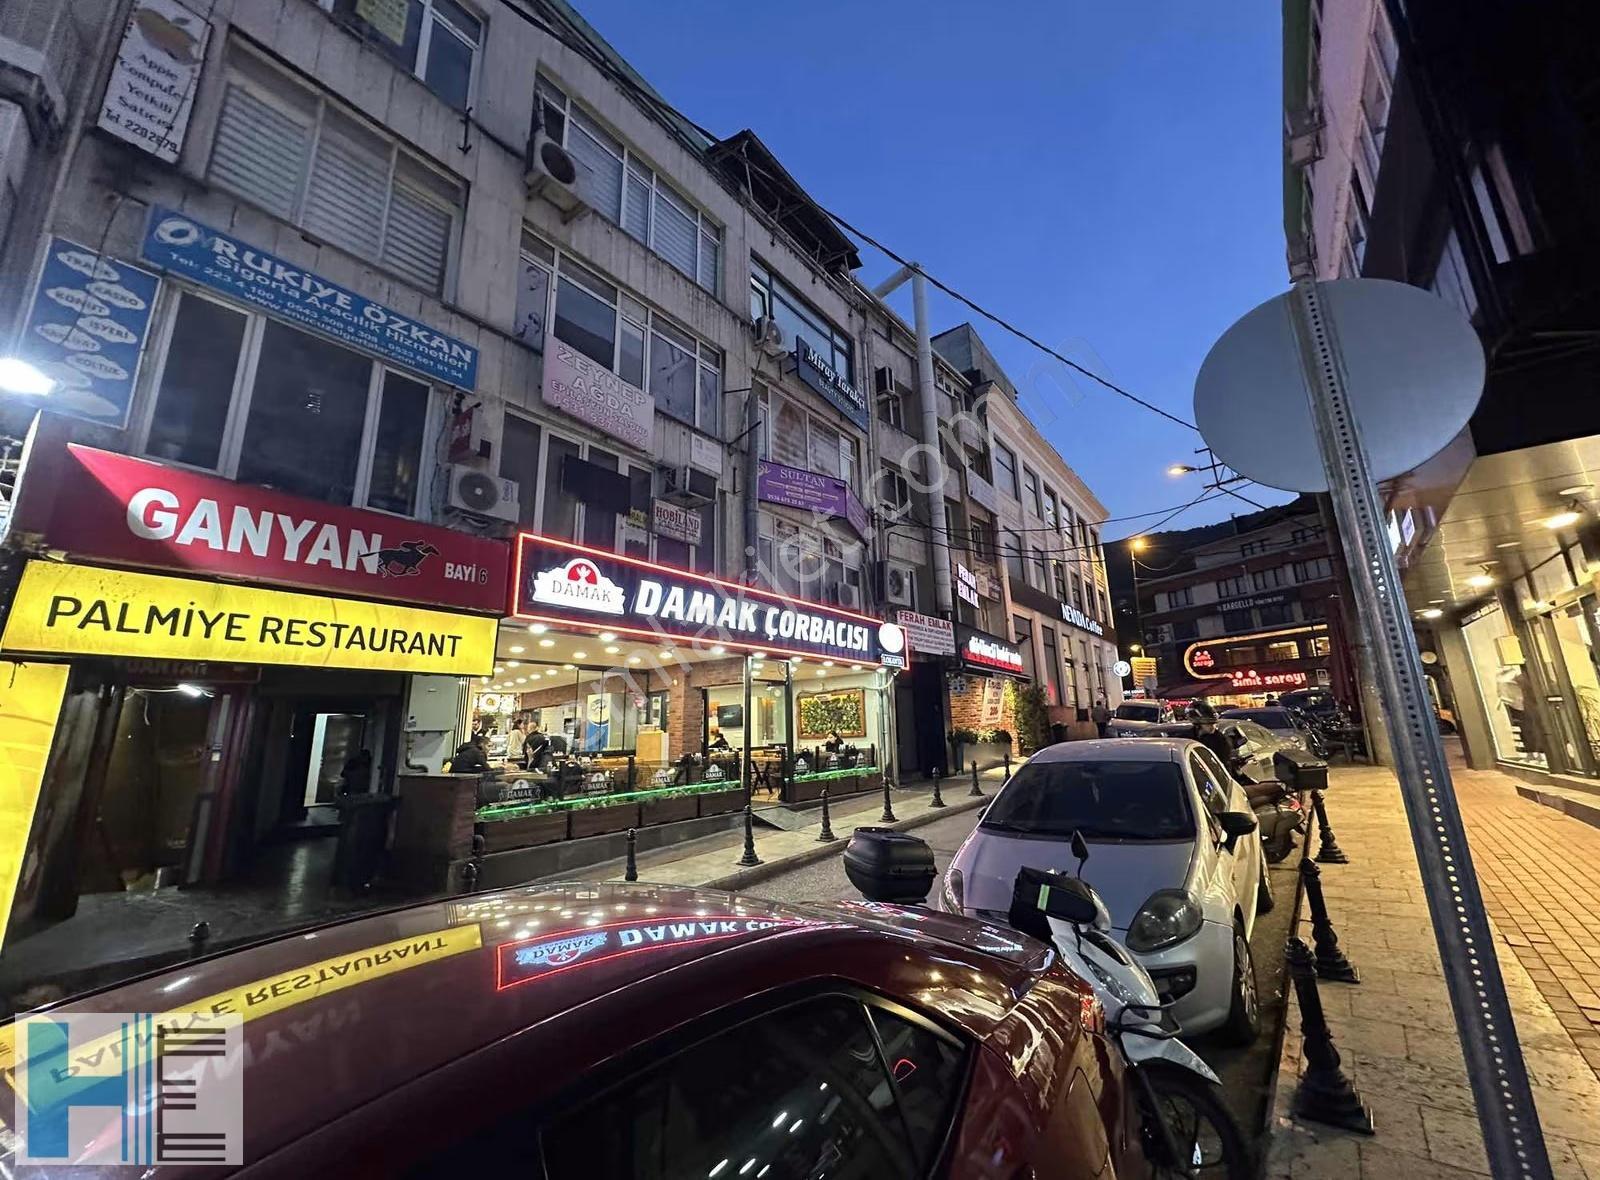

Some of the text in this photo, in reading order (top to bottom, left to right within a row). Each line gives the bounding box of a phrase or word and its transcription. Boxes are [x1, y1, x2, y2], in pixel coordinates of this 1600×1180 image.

[137, 54, 178, 81] Apple
[212, 236, 472, 363] RUKİYE ÖZKAN
[215, 254, 468, 371] Sigorta Aracılık Hizmetleri
[808, 348, 836, 382] Miray
[780, 468, 825, 487] SULTAN
[127, 487, 488, 584] GANYAN BAYİ 6
[552, 581, 612, 603] DAMAK
[47, 595, 463, 658] PALMİYE RESTAURANT
[635, 580, 757, 632] DAMAK
[764, 608, 868, 652] ÇORBACISI
[900, 611, 925, 625] FERAH
[1232, 671, 1306, 687] simit sarayı
